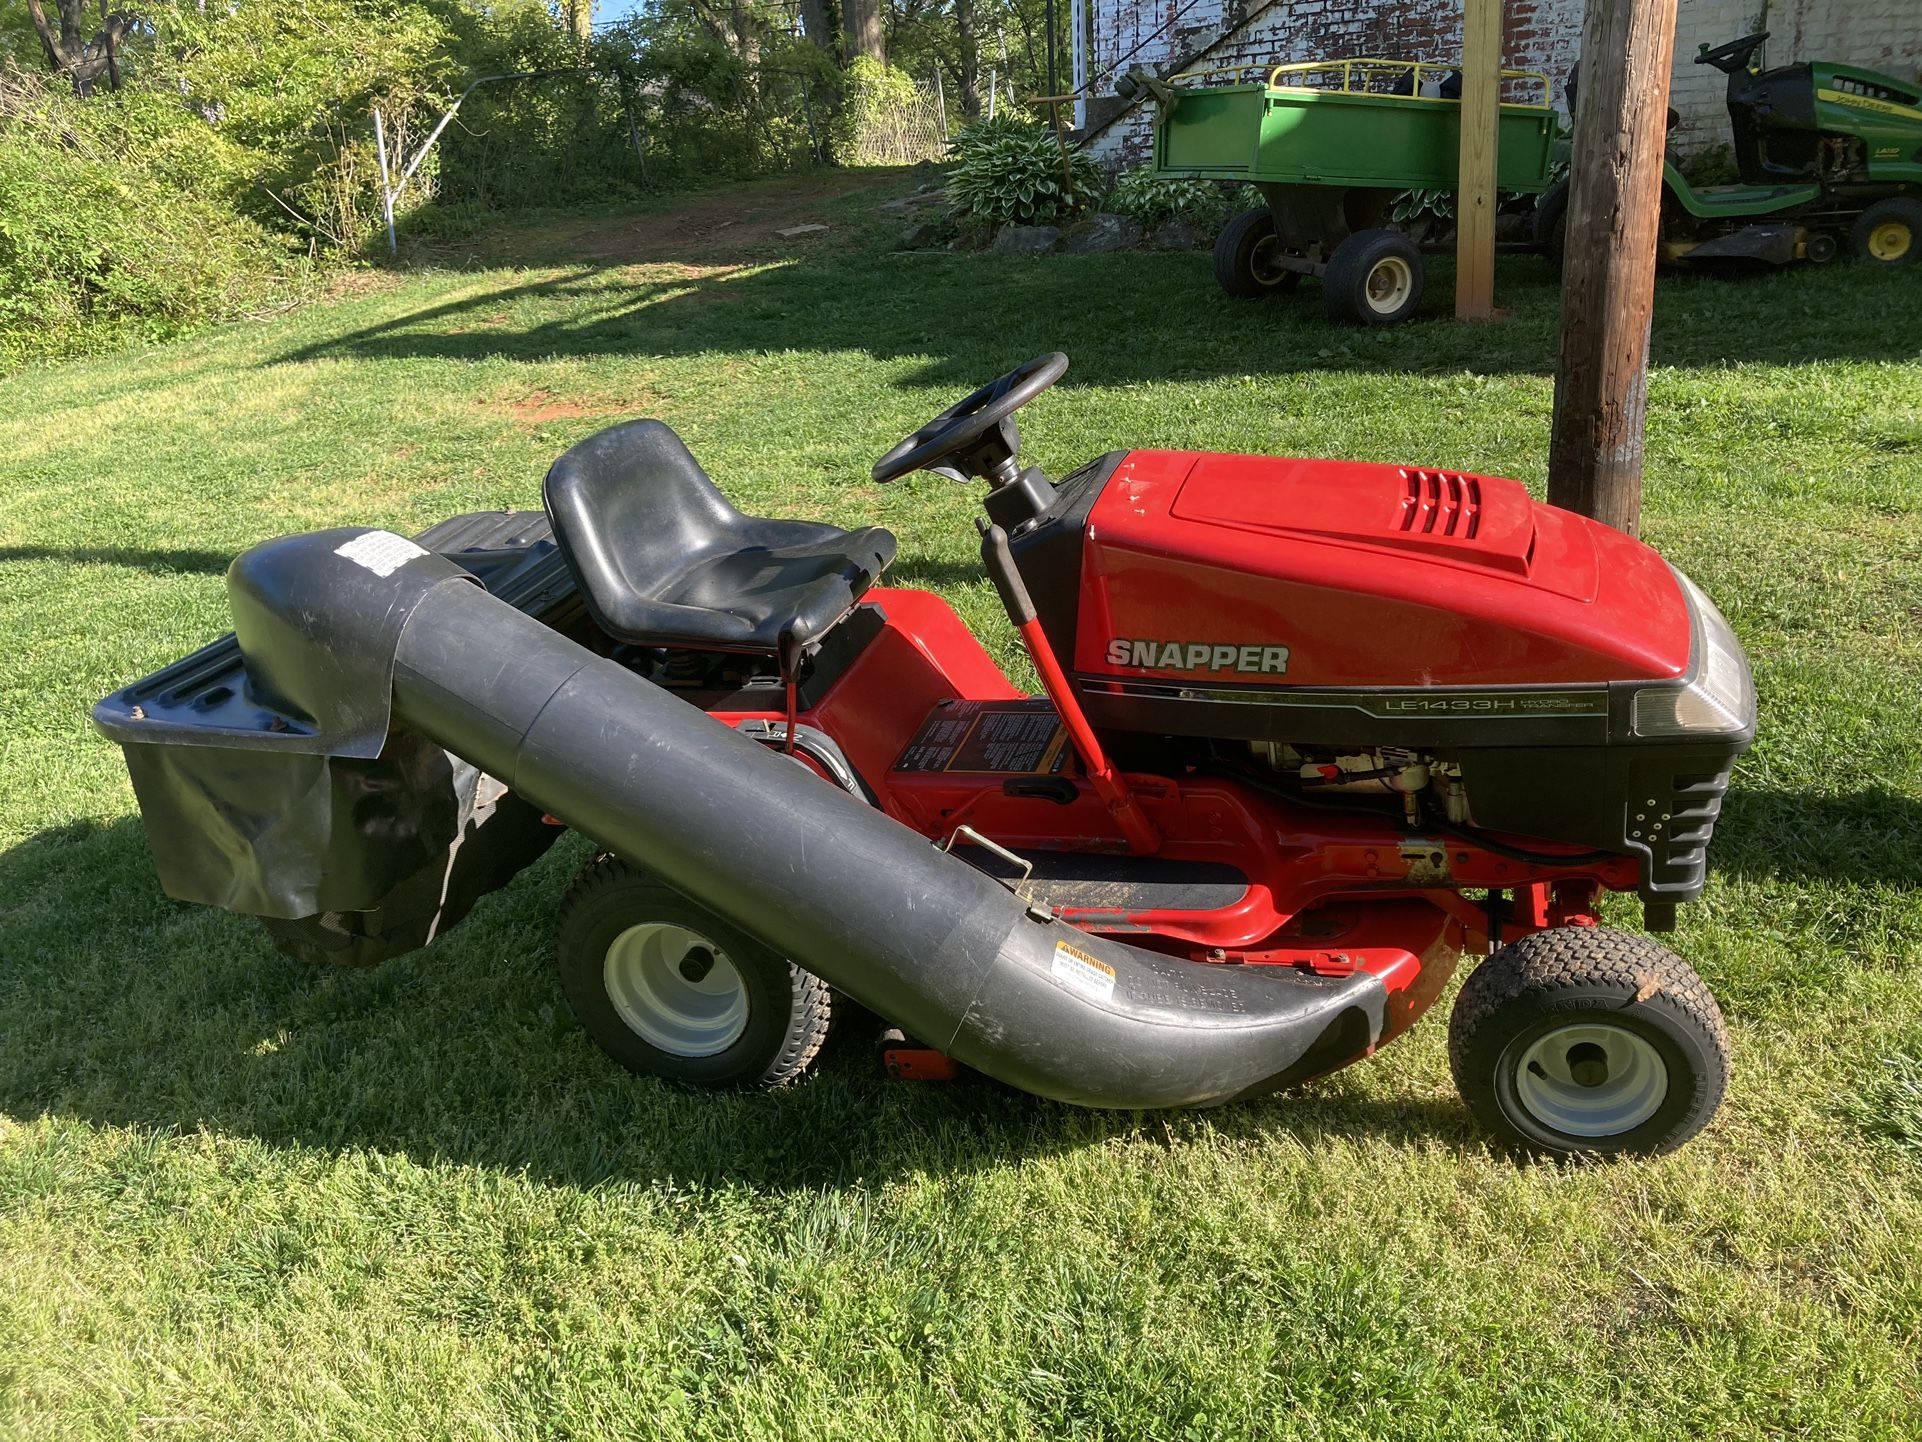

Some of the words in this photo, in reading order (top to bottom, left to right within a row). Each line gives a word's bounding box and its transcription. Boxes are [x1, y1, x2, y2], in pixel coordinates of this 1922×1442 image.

[1834, 95, 1861, 106] JOHN
[1863, 99, 1893, 113] DEERE
[1107, 639, 1290, 673] SNAPPER
[1385, 699, 1515, 711] LE1433H
[1069, 946, 1112, 975] WARNING
